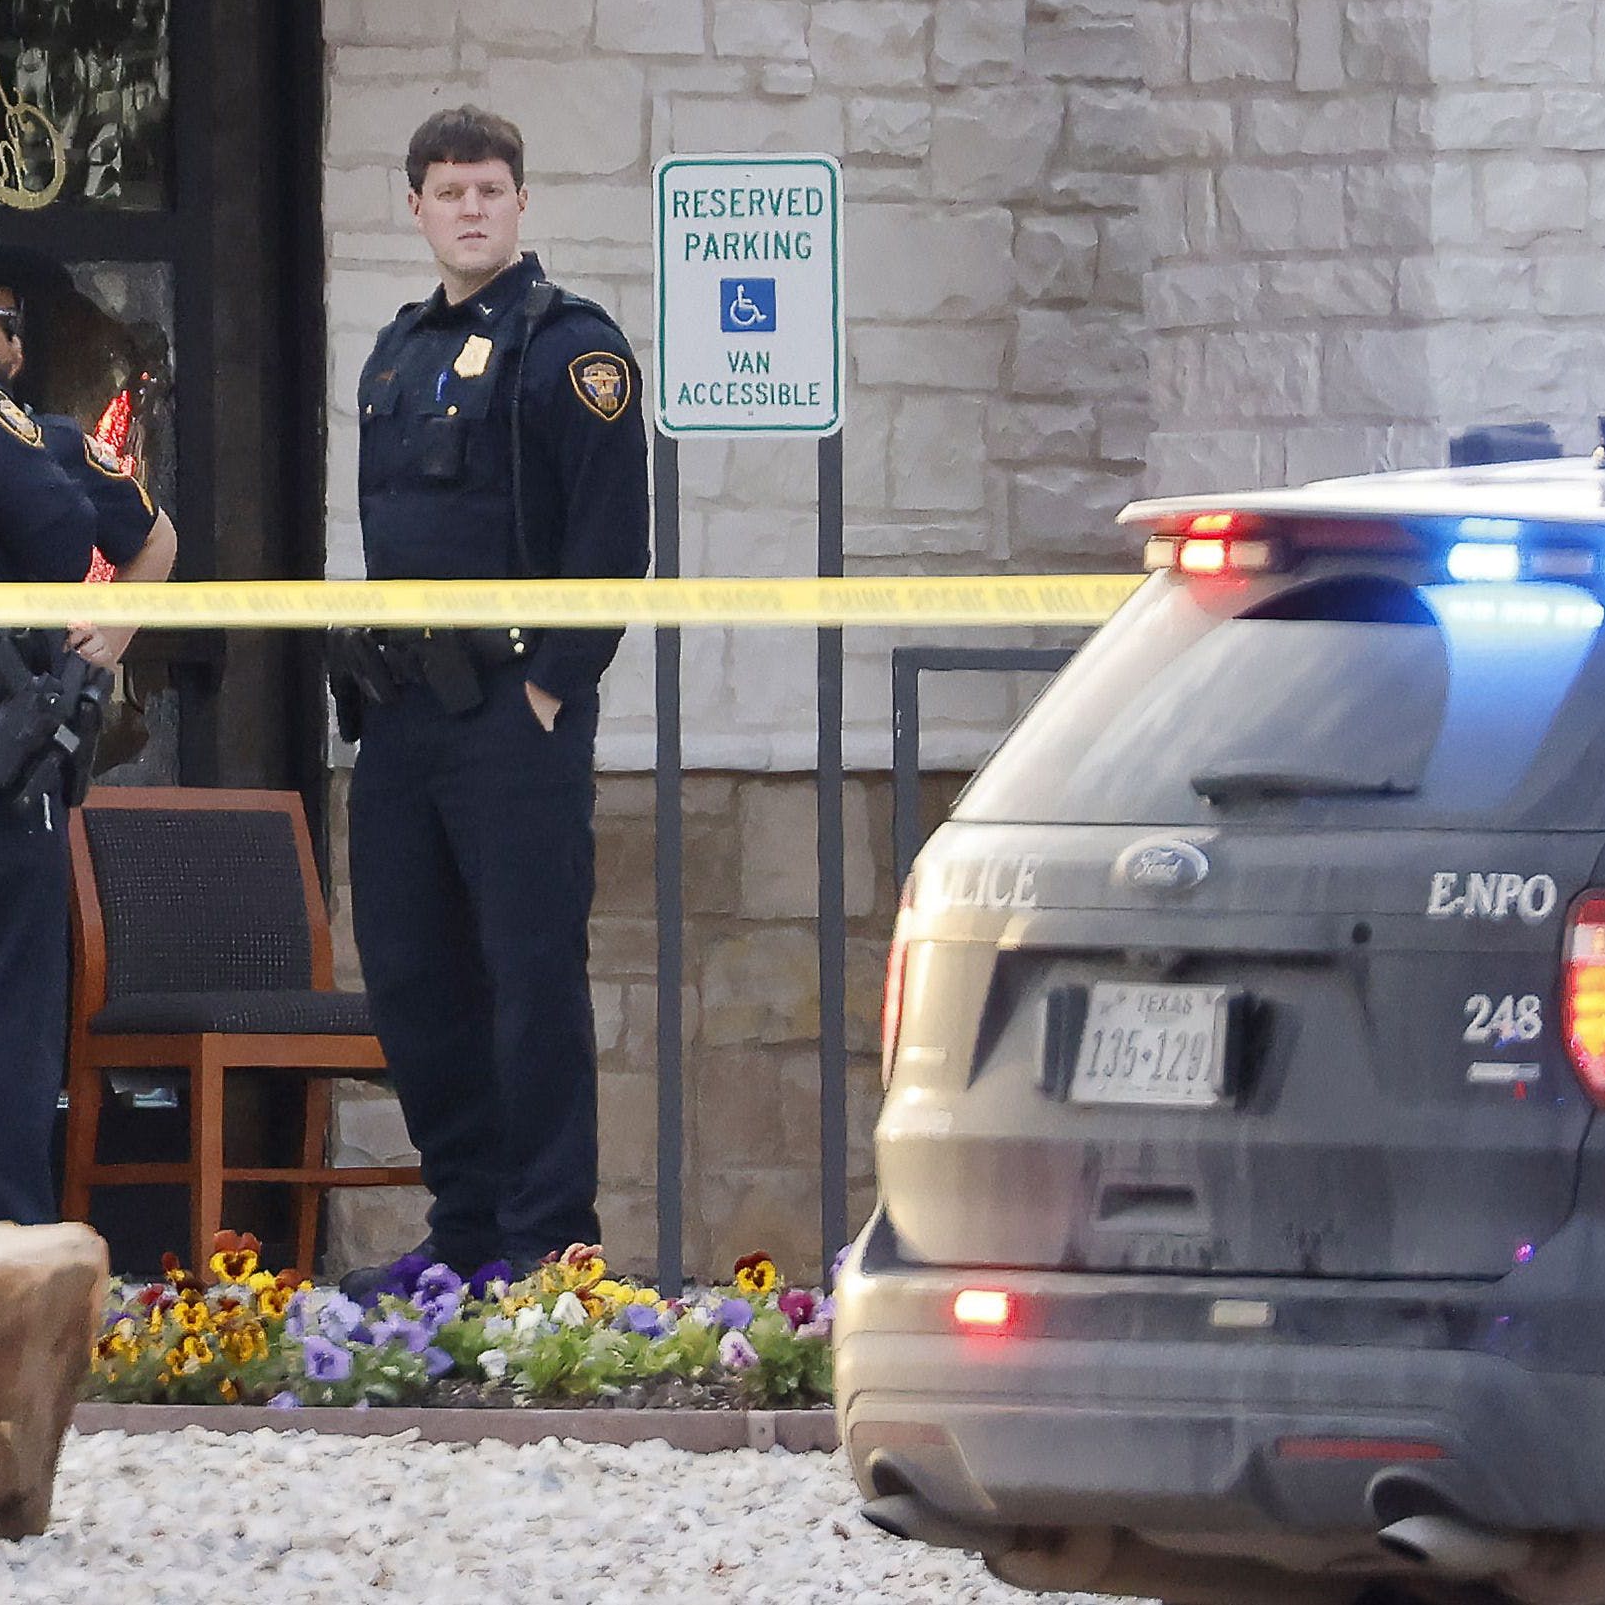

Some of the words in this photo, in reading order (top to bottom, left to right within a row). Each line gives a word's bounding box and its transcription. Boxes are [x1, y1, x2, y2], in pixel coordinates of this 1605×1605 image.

[672, 186, 824, 219] RESERVED
[684, 231, 813, 262] PARKING
[727, 350, 771, 375] VAN
[677, 382, 822, 407] ACCESSIBLE
[1136, 993, 1194, 1015] TEXAS
[1463, 994, 1544, 1043] 248
